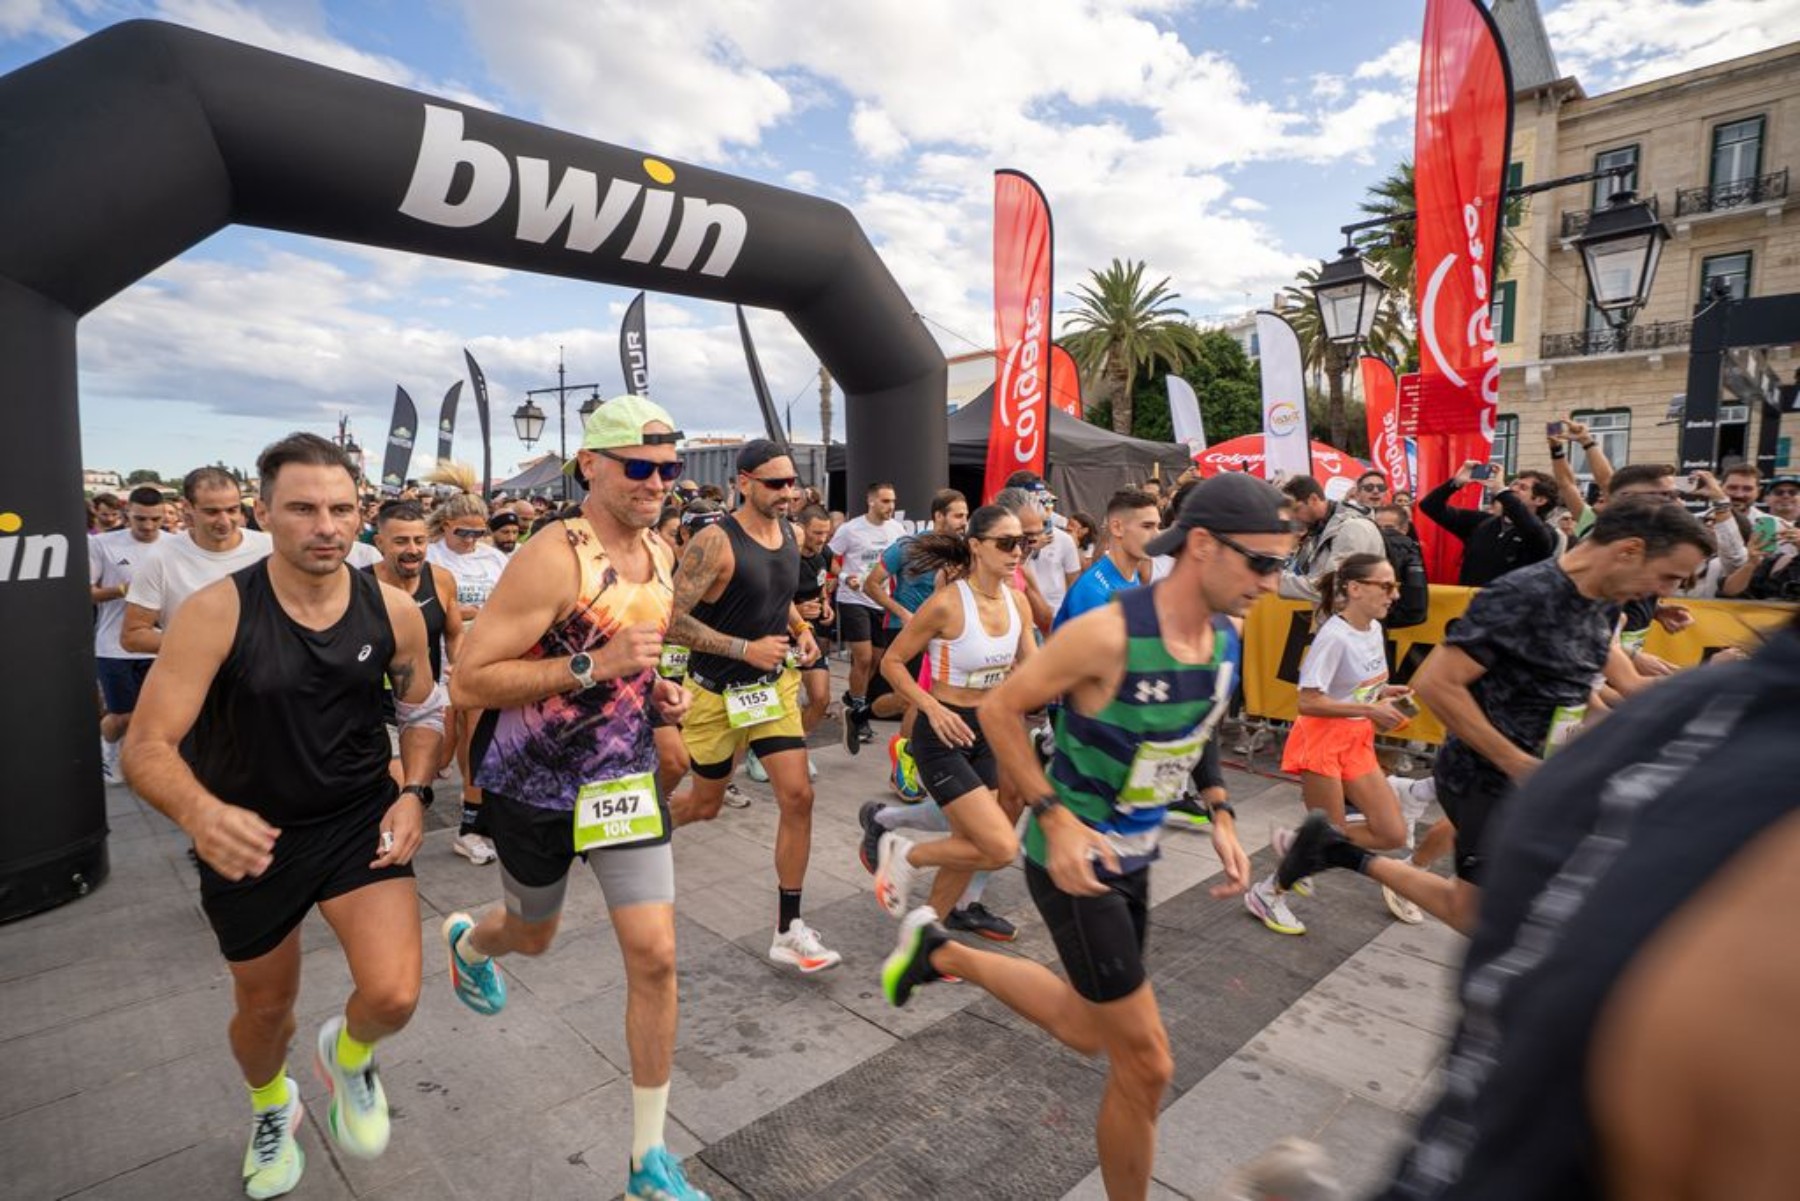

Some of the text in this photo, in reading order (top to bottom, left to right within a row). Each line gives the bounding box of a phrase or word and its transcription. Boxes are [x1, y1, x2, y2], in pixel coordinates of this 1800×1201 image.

[398, 103, 748, 277] bwin
[738, 690, 769, 707] 1155
[592, 796, 640, 819] 1547
[603, 819, 633, 838] 10K
